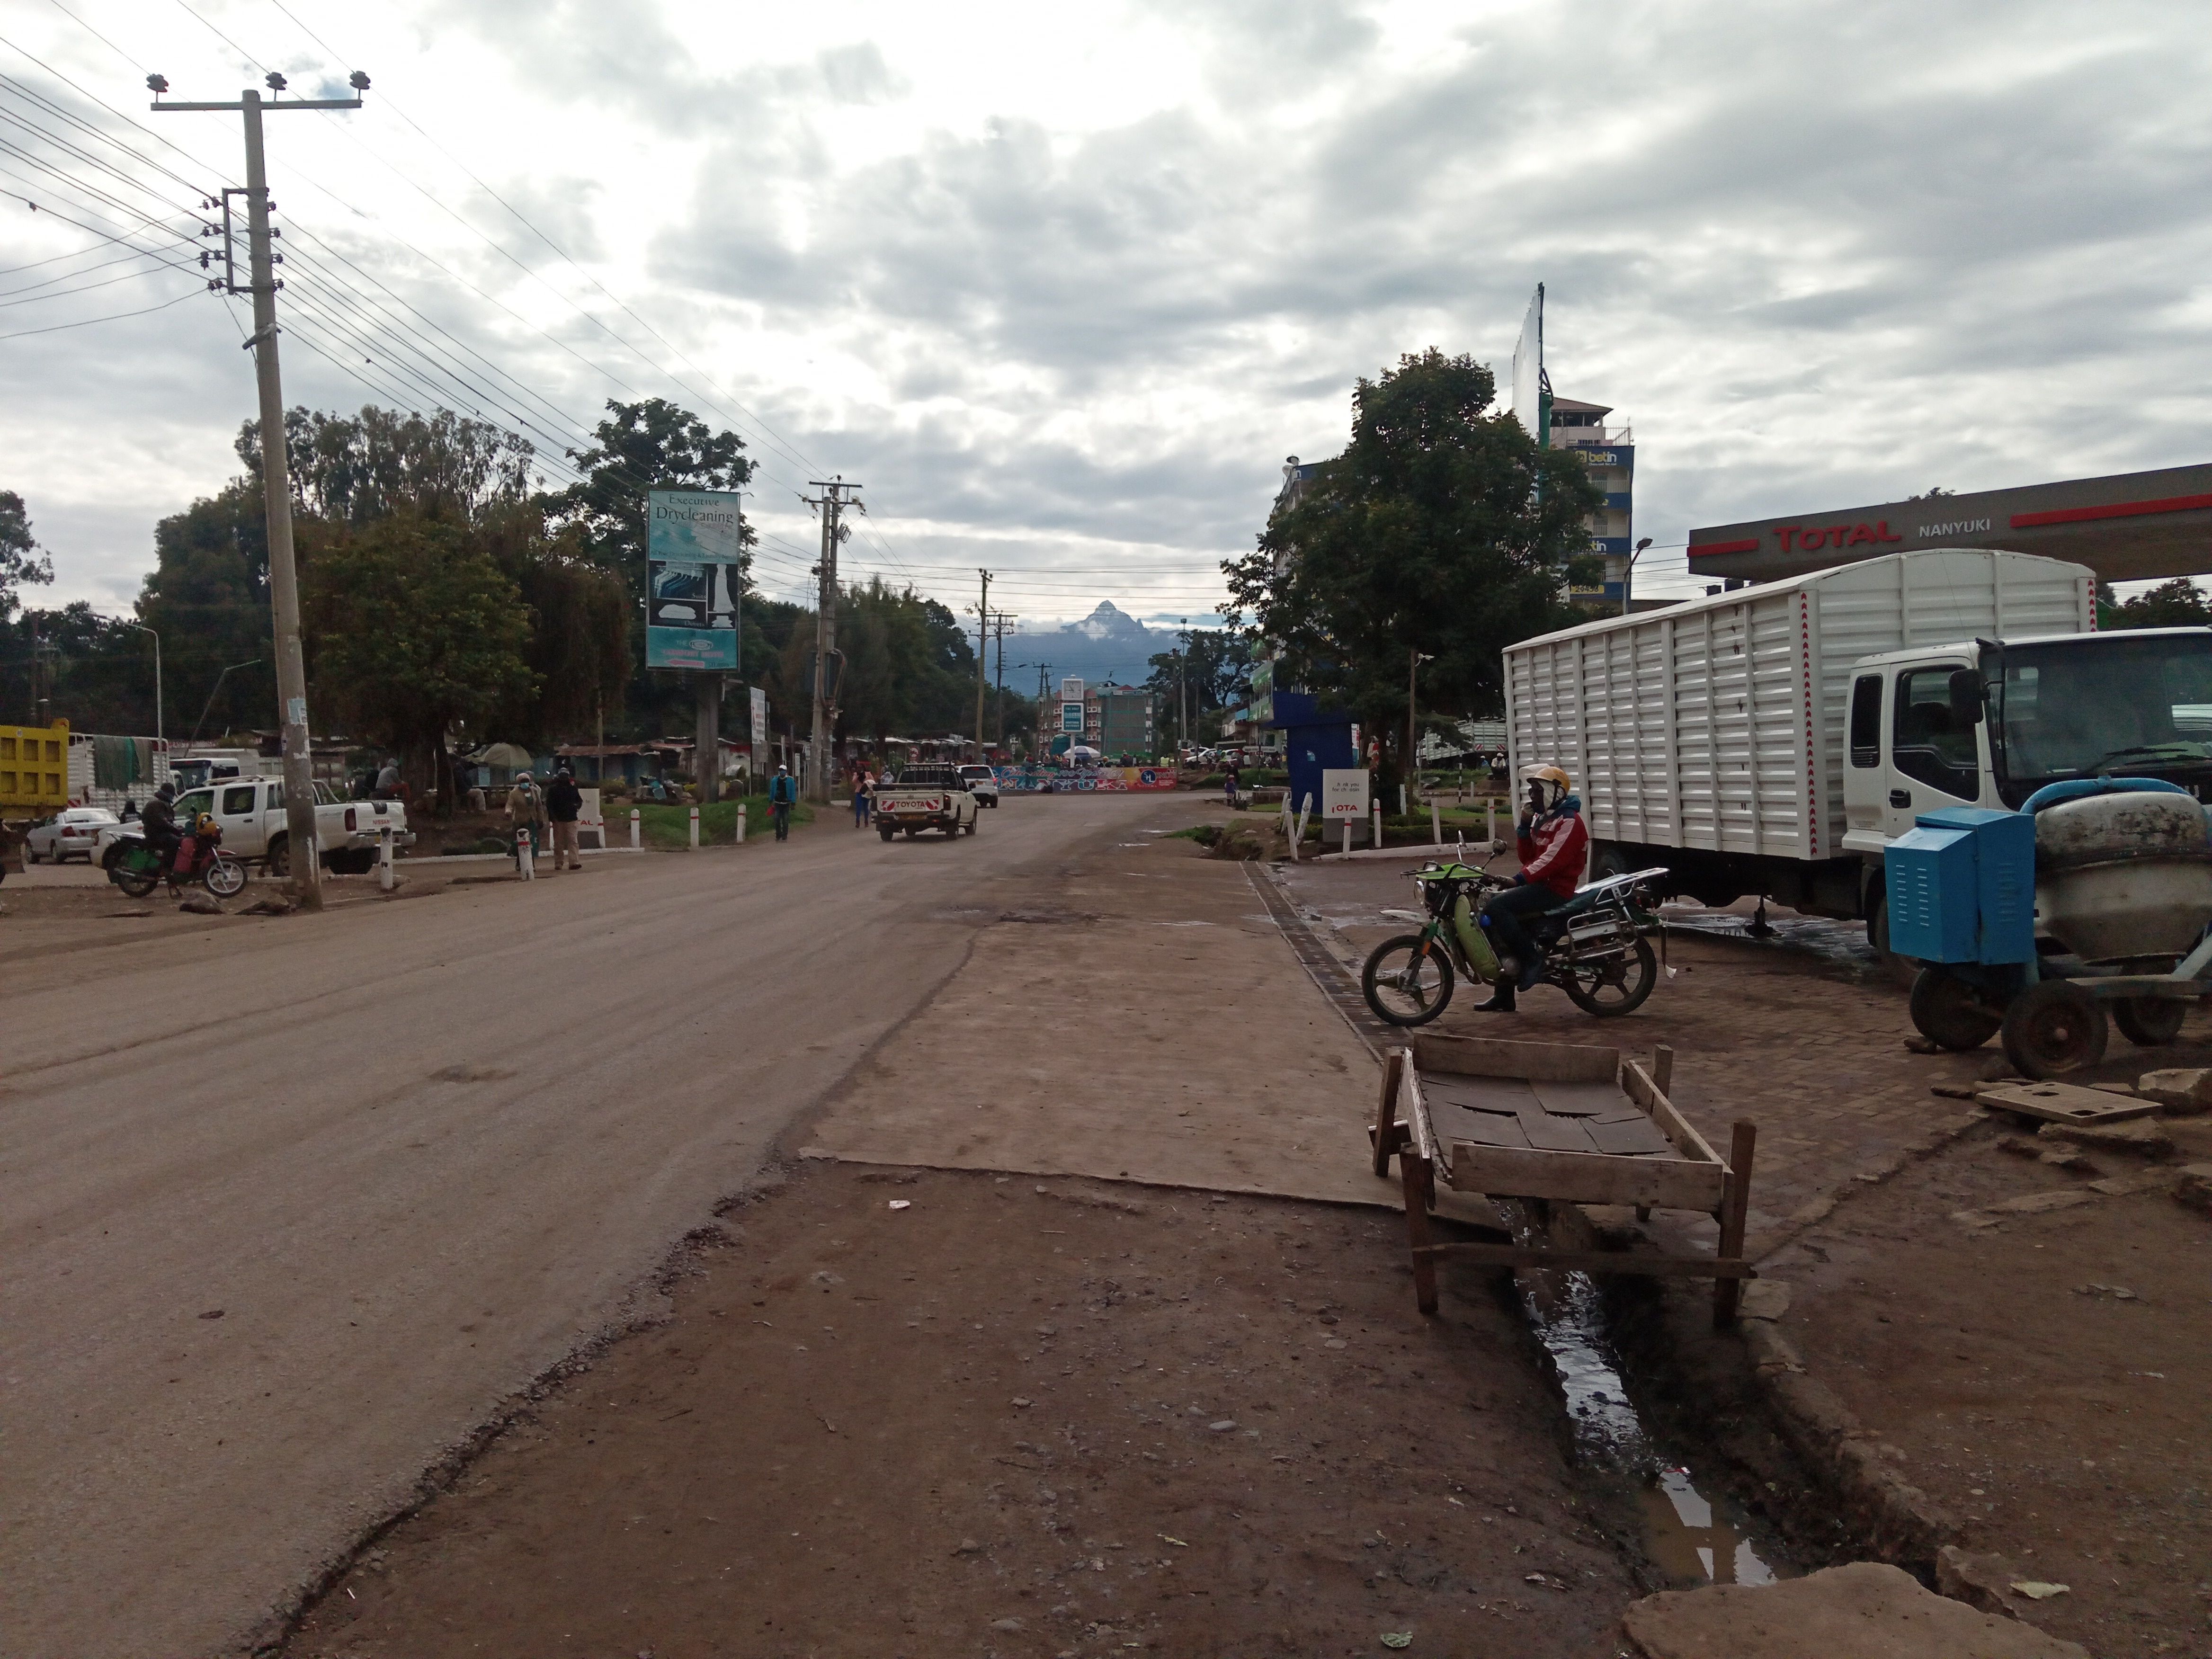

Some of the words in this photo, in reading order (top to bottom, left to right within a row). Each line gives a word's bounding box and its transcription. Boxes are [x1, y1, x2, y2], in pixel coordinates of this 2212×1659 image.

[1589, 451, 1617, 463] betin
[669, 494, 720, 506] Executive
[657, 507, 733, 524] Drycleaning
[1773, 520, 1902, 553] TOTAL
[1919, 518, 1991, 538] NANYUKI
